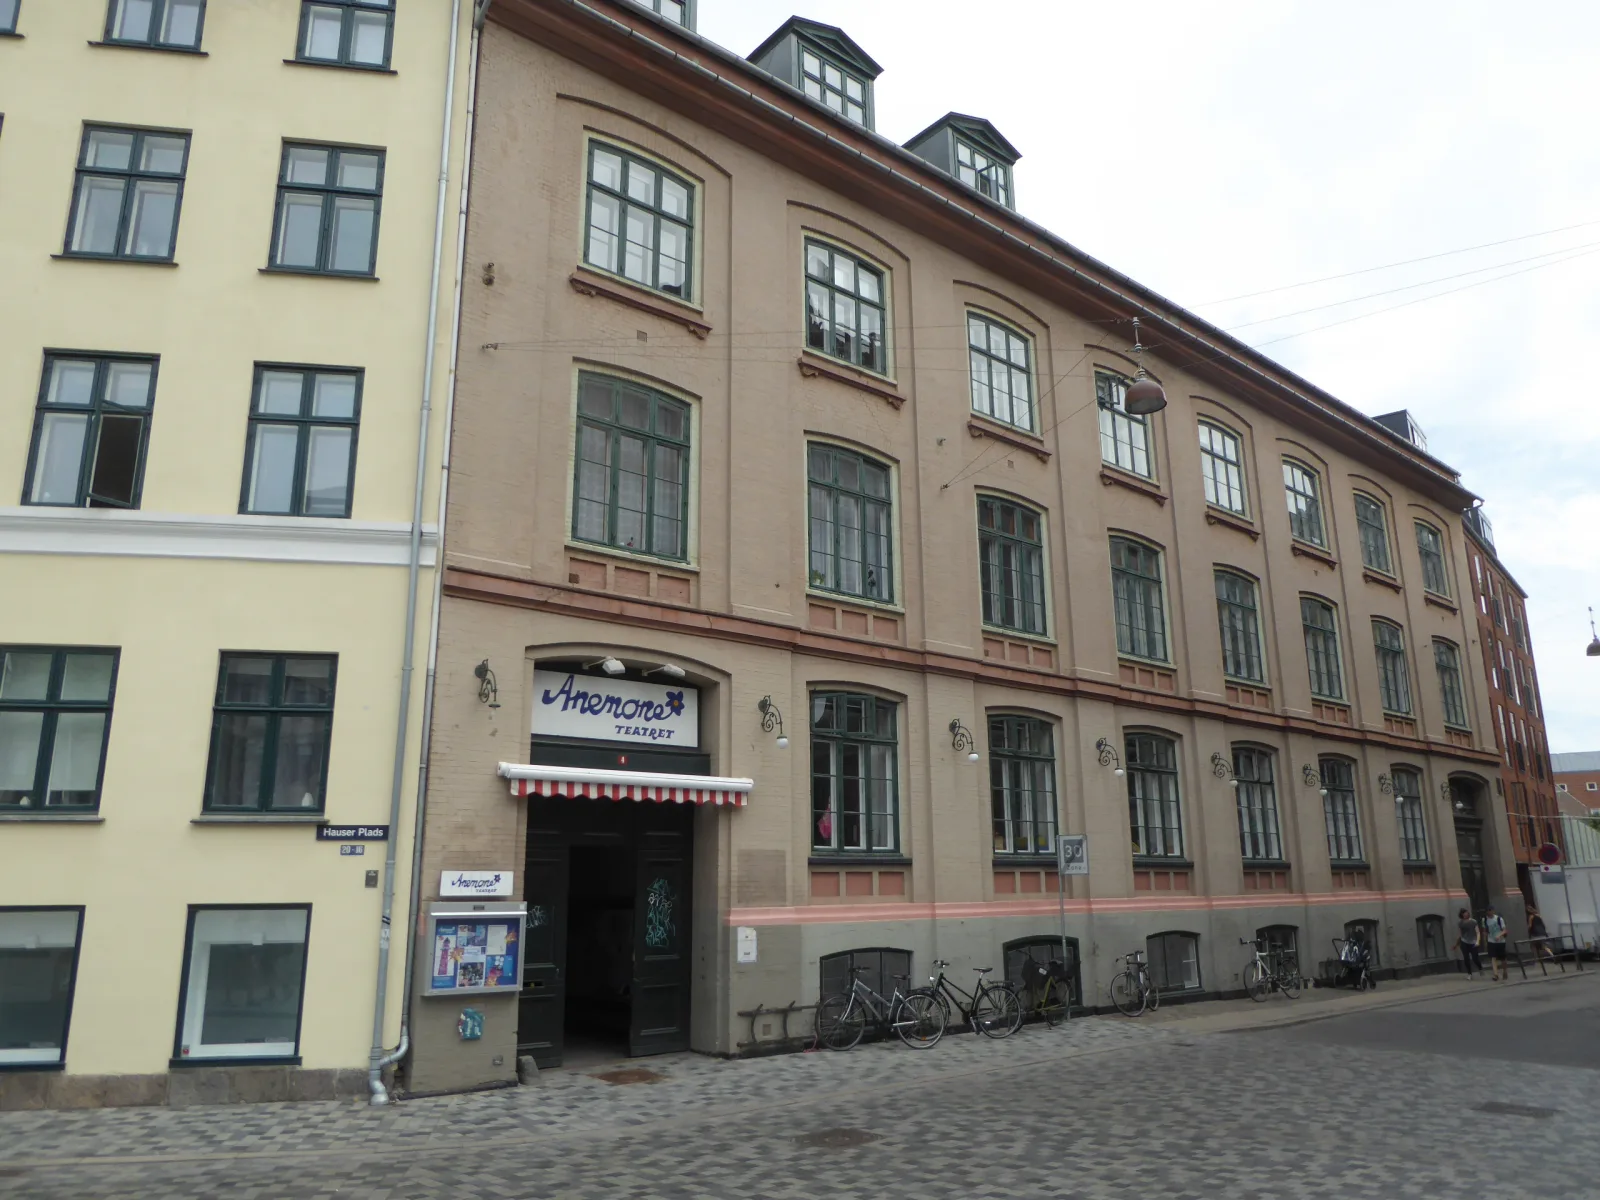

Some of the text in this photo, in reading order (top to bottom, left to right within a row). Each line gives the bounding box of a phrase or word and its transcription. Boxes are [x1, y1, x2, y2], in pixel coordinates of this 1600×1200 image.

[541, 674, 674, 722] Anemone
[615, 725, 675, 740] TEATRET
[620, 756, 625, 764] 4
[323, 827, 383, 837] Hauser Plads
[1065, 845, 1082, 858] 30
[451, 873, 496, 888] Anemone
